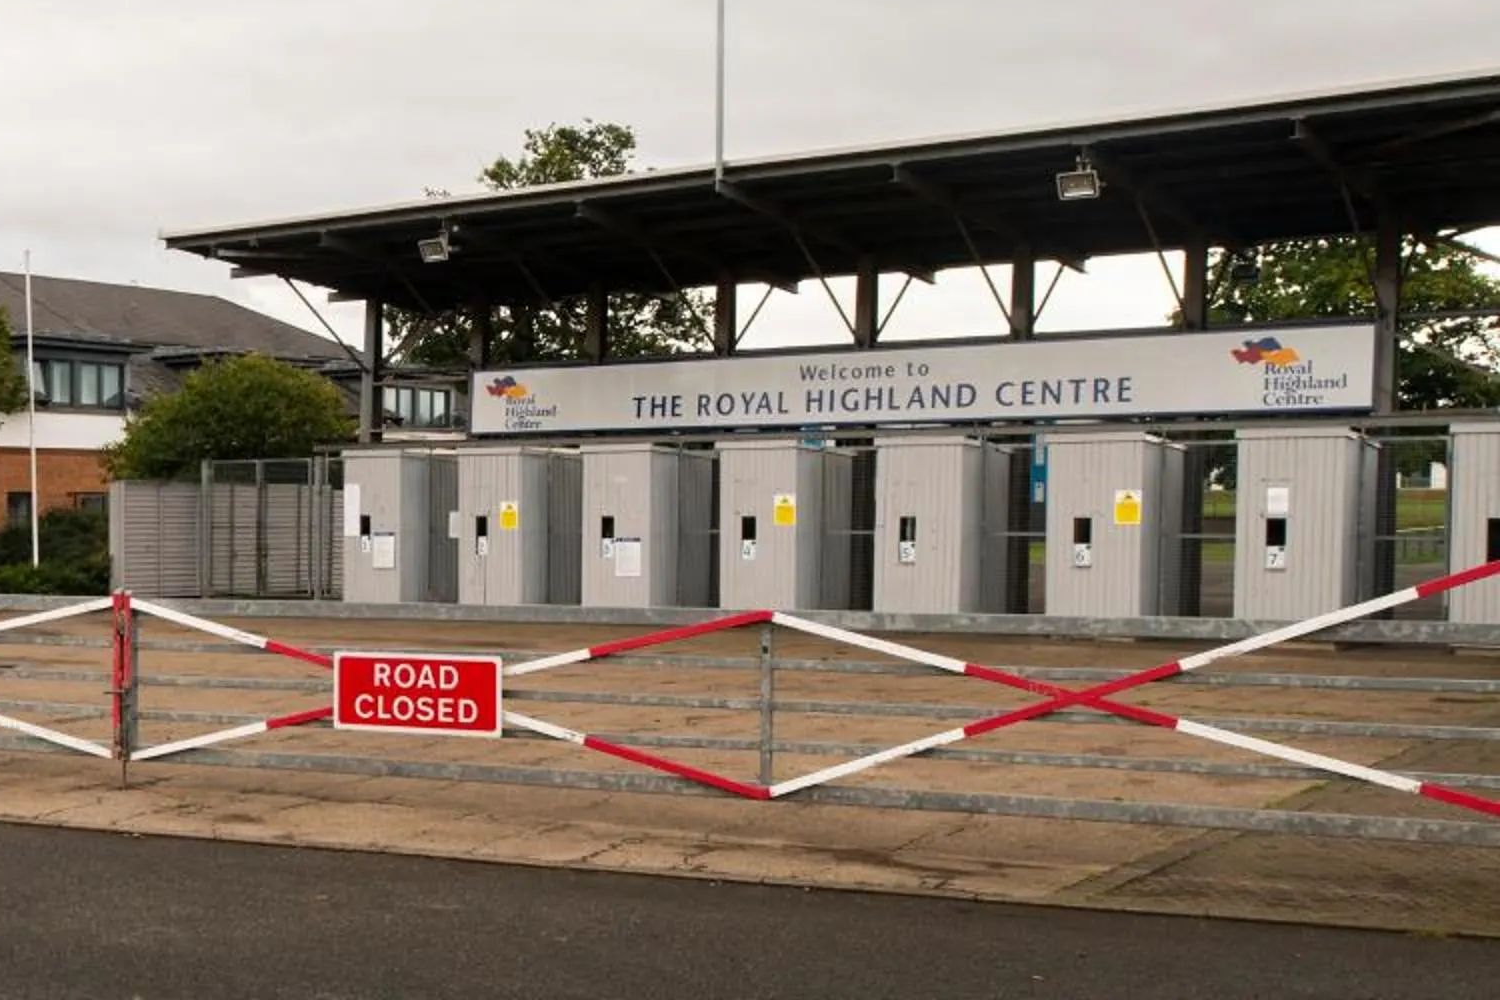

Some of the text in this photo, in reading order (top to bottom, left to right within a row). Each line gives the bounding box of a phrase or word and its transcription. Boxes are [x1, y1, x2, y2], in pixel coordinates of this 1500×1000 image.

[799, 363, 930, 381] Welcome to
[1265, 359, 1313, 377] Royal
[1264, 373, 1347, 394] Highland
[632, 376, 1134, 419] THE ROYAL HIGHLAND CENTRE
[1263, 392, 1325, 406] Centre
[373, 663, 459, 690] ROAD
[354, 693, 479, 724] CLOSED
